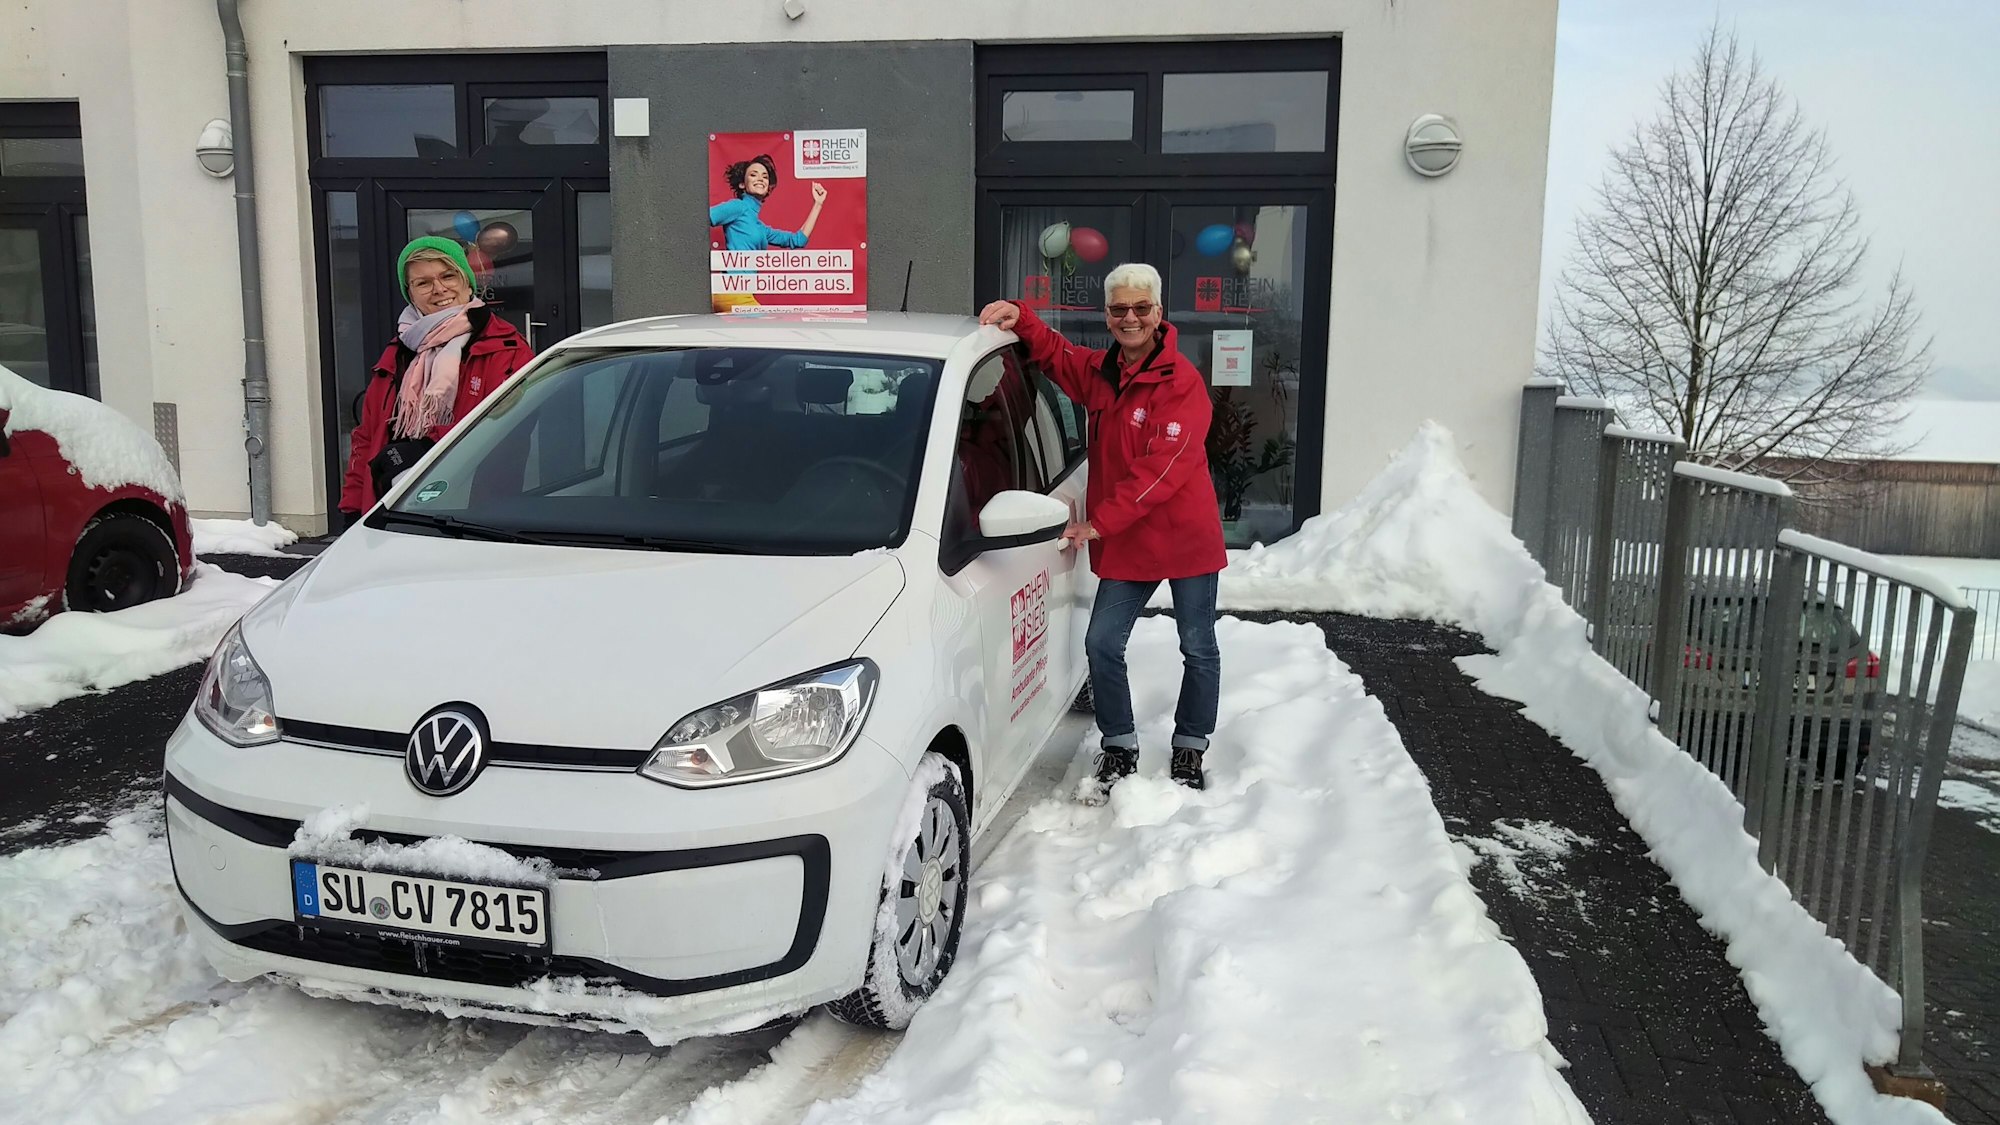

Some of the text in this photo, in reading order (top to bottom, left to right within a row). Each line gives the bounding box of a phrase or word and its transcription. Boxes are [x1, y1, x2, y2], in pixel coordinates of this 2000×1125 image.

[822, 138, 859, 149] RHEIN
[822, 150, 851, 161] SIEG
[721, 252, 848, 268] Wir stellen ein.
[722, 275, 850, 291] Wir bilden aus.
[1025, 567, 1050, 611] RHEIN
[1026, 601, 1046, 639] SIEG
[304, 893, 313, 906] D
[322, 871, 539, 935] SU CV 7815
[378, 930, 461, 946] www.fleischhauer.com
